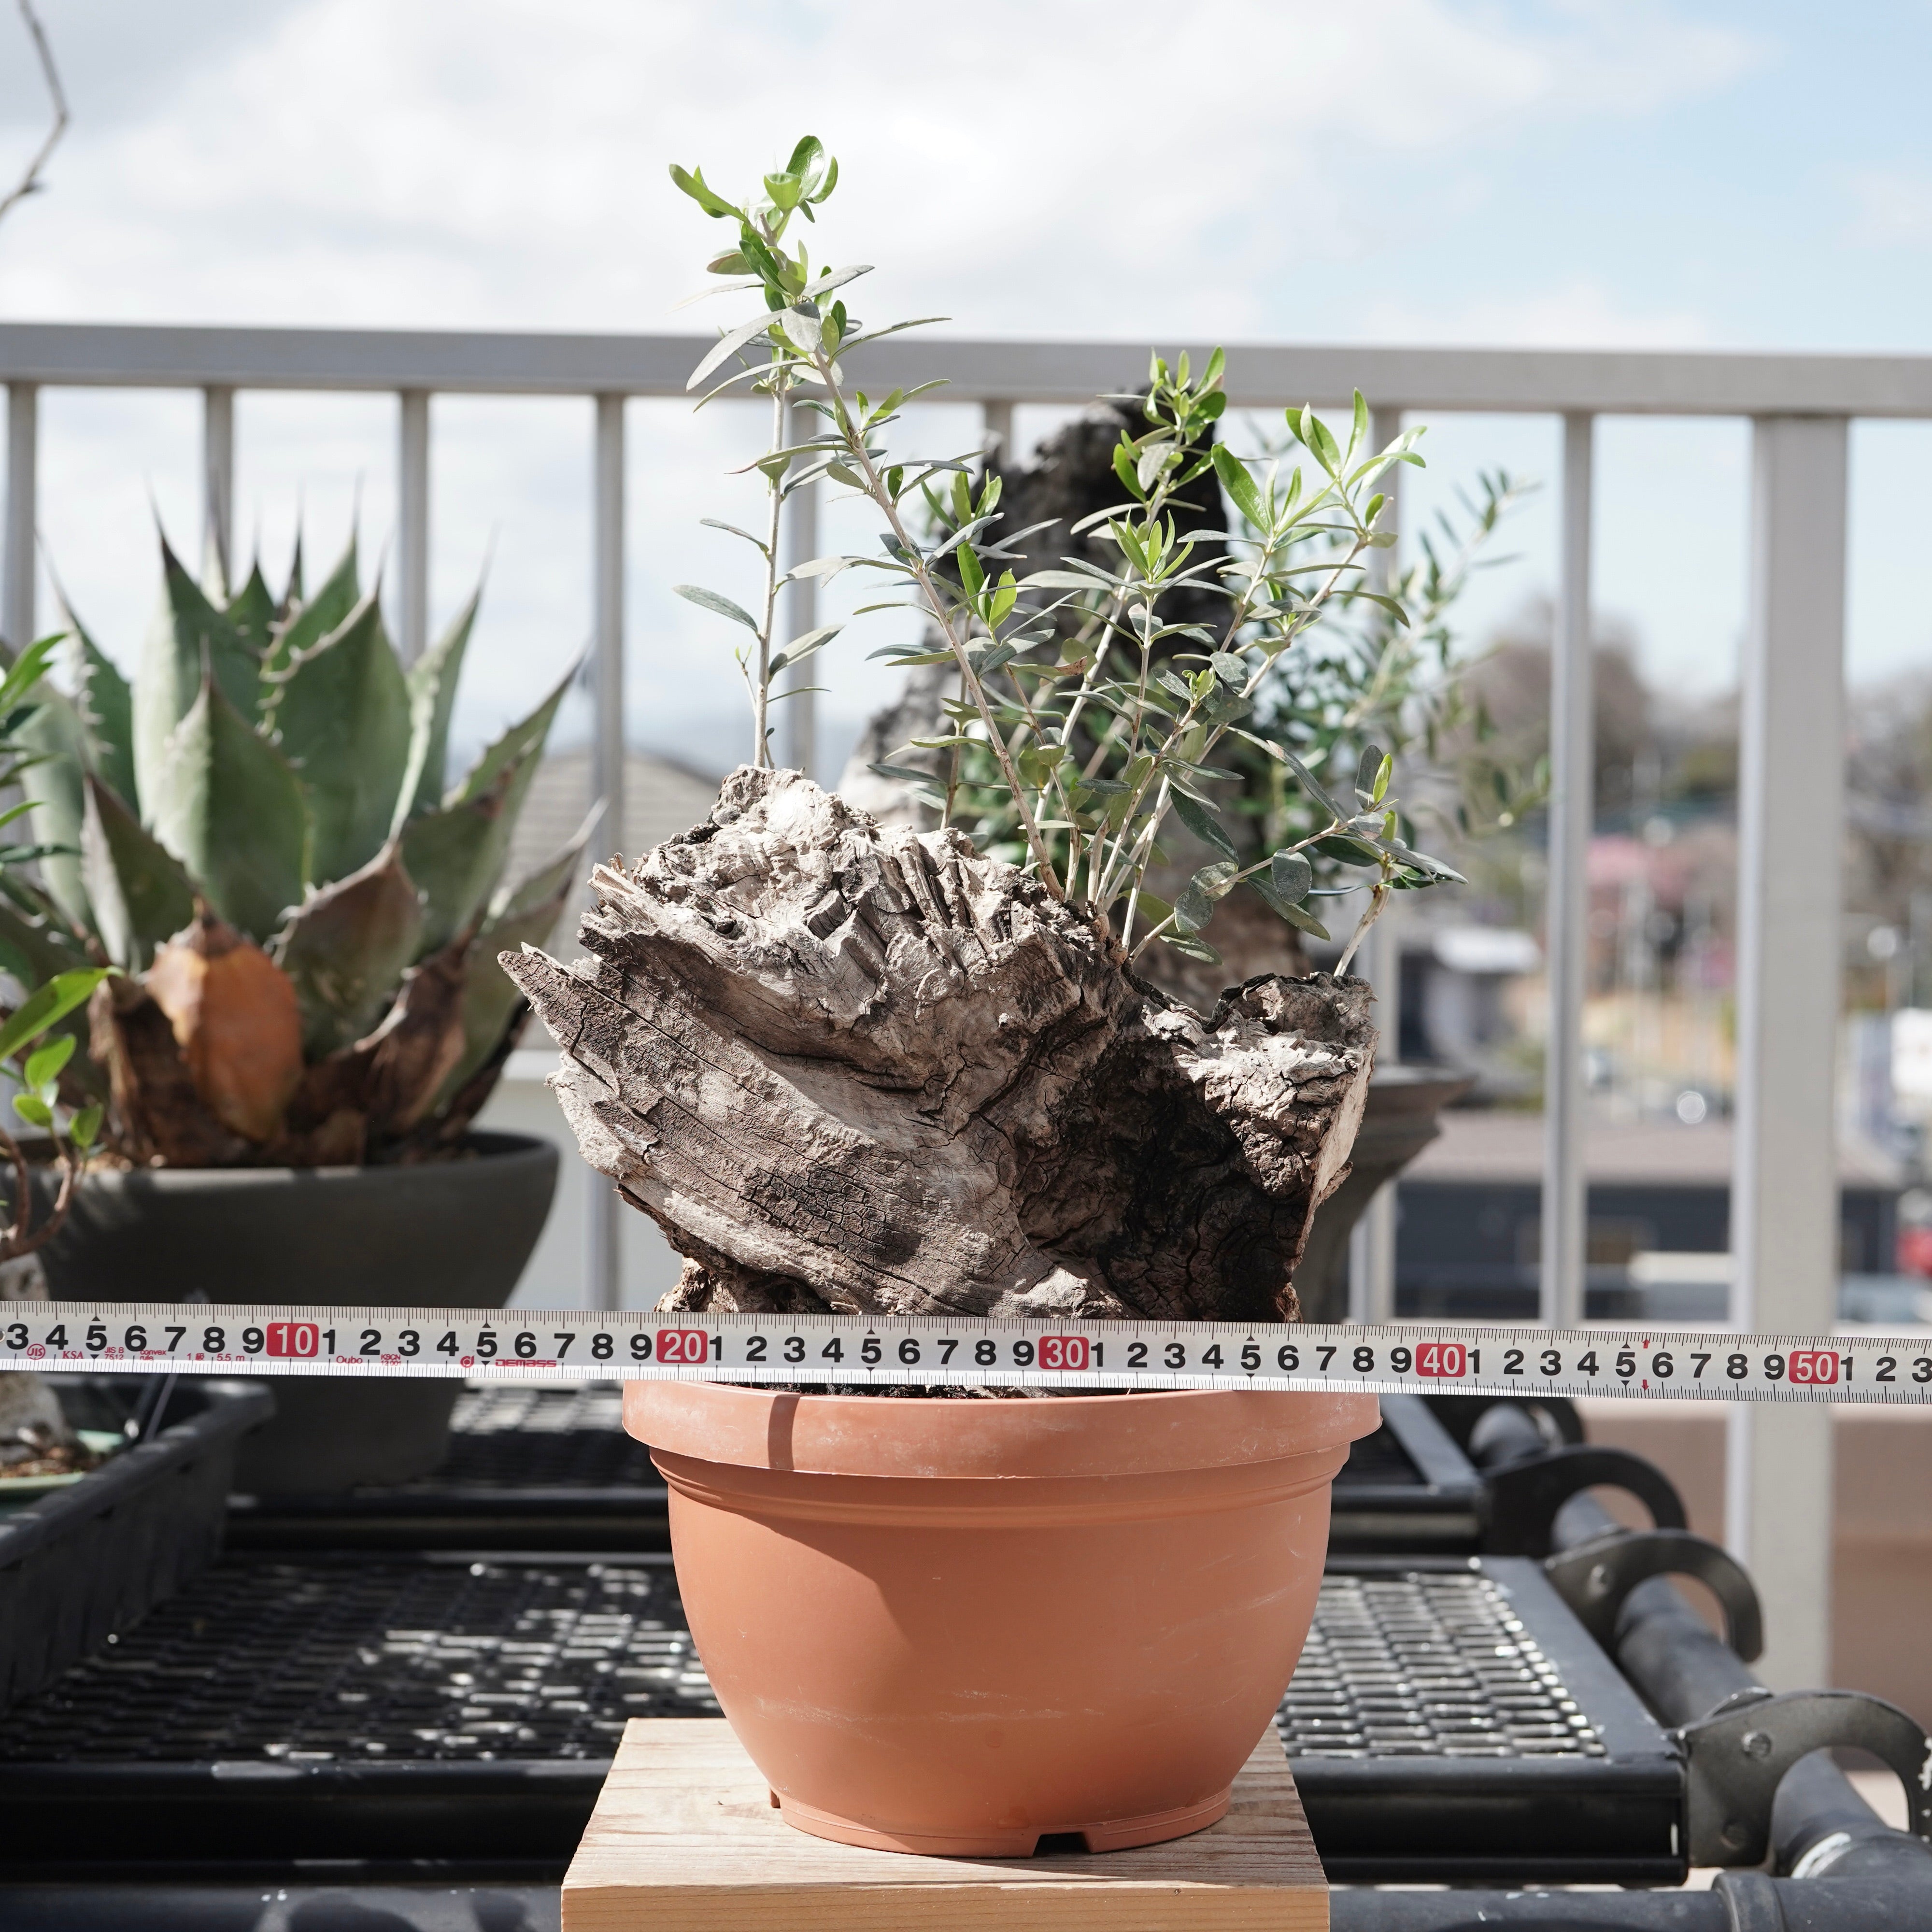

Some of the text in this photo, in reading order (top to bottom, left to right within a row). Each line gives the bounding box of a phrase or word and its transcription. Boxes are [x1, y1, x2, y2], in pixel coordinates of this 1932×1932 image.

[6, 1323, 1932, 1383] 3 4 5 6 7 8 9 10 1 2 3 4 5 6 7 8 9 20 1 2 3 4 5 6 7 8 9 30 1 2 3 4 5 6 7 8 9 40 1 2 3 4 5 6 7 8 9 50 1 2 3
[62, 1350, 84, 1359] KSA
